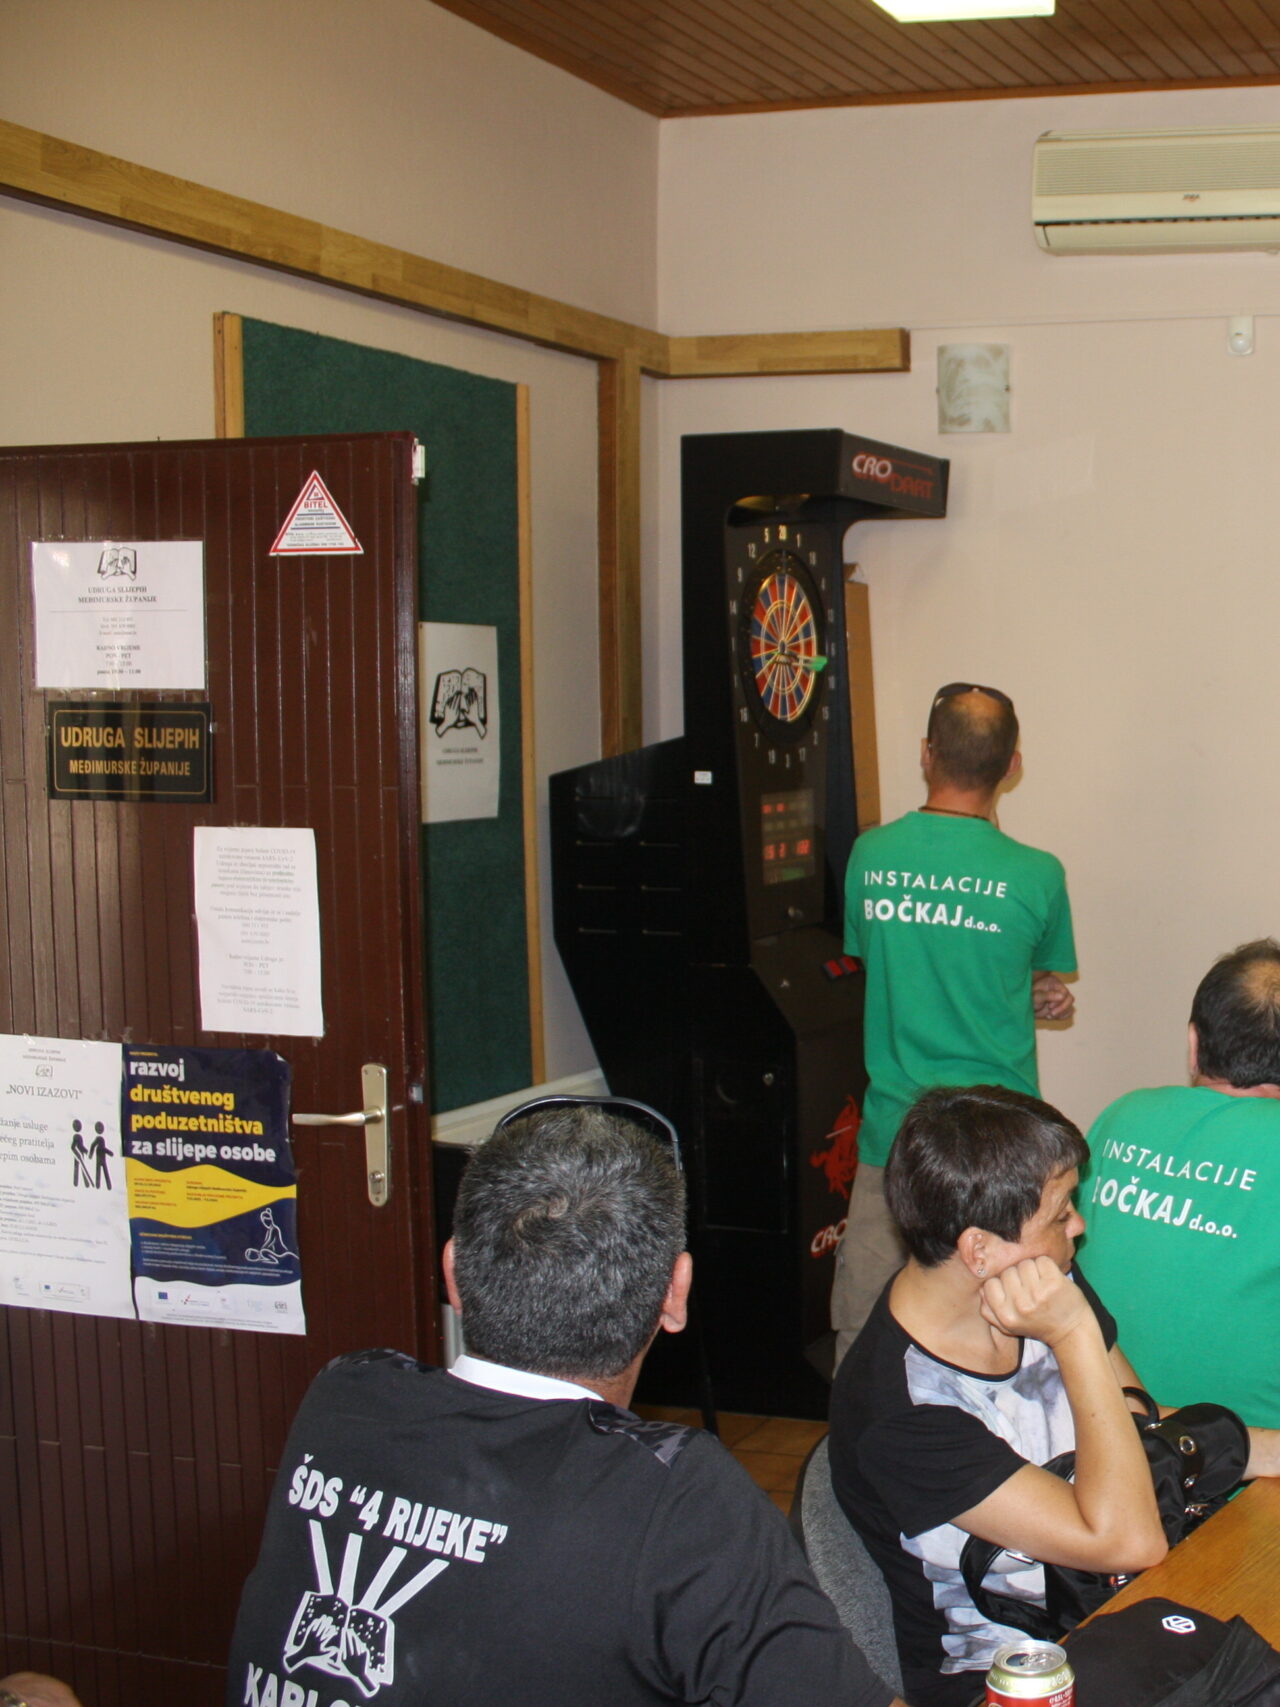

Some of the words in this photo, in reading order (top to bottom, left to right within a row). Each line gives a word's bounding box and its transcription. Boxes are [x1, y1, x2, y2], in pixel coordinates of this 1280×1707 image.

[852, 454, 892, 478] CRO
[303, 501, 328, 509] BITEL
[61, 726, 126, 748] UDRUGA
[133, 728, 200, 748] SLIJEPIH
[69, 759, 137, 775] MEĐIMURSKE
[139, 757, 191, 776] ŽUPANIJE
[864, 870, 1008, 898] INSTALACIJE
[864, 894, 963, 927] BOČKAJ
[129, 1058, 185, 1082] razvoj
[130, 1084, 235, 1111] društvenog
[131, 1112, 264, 1136] poduzetništva
[131, 1140, 153, 1155] za
[156, 1137, 218, 1162] slijepe
[220, 1143, 277, 1162] osobe
[1102, 1138, 1258, 1191] INSTALACIJE
[288, 1452, 344, 1518] ŠDS
